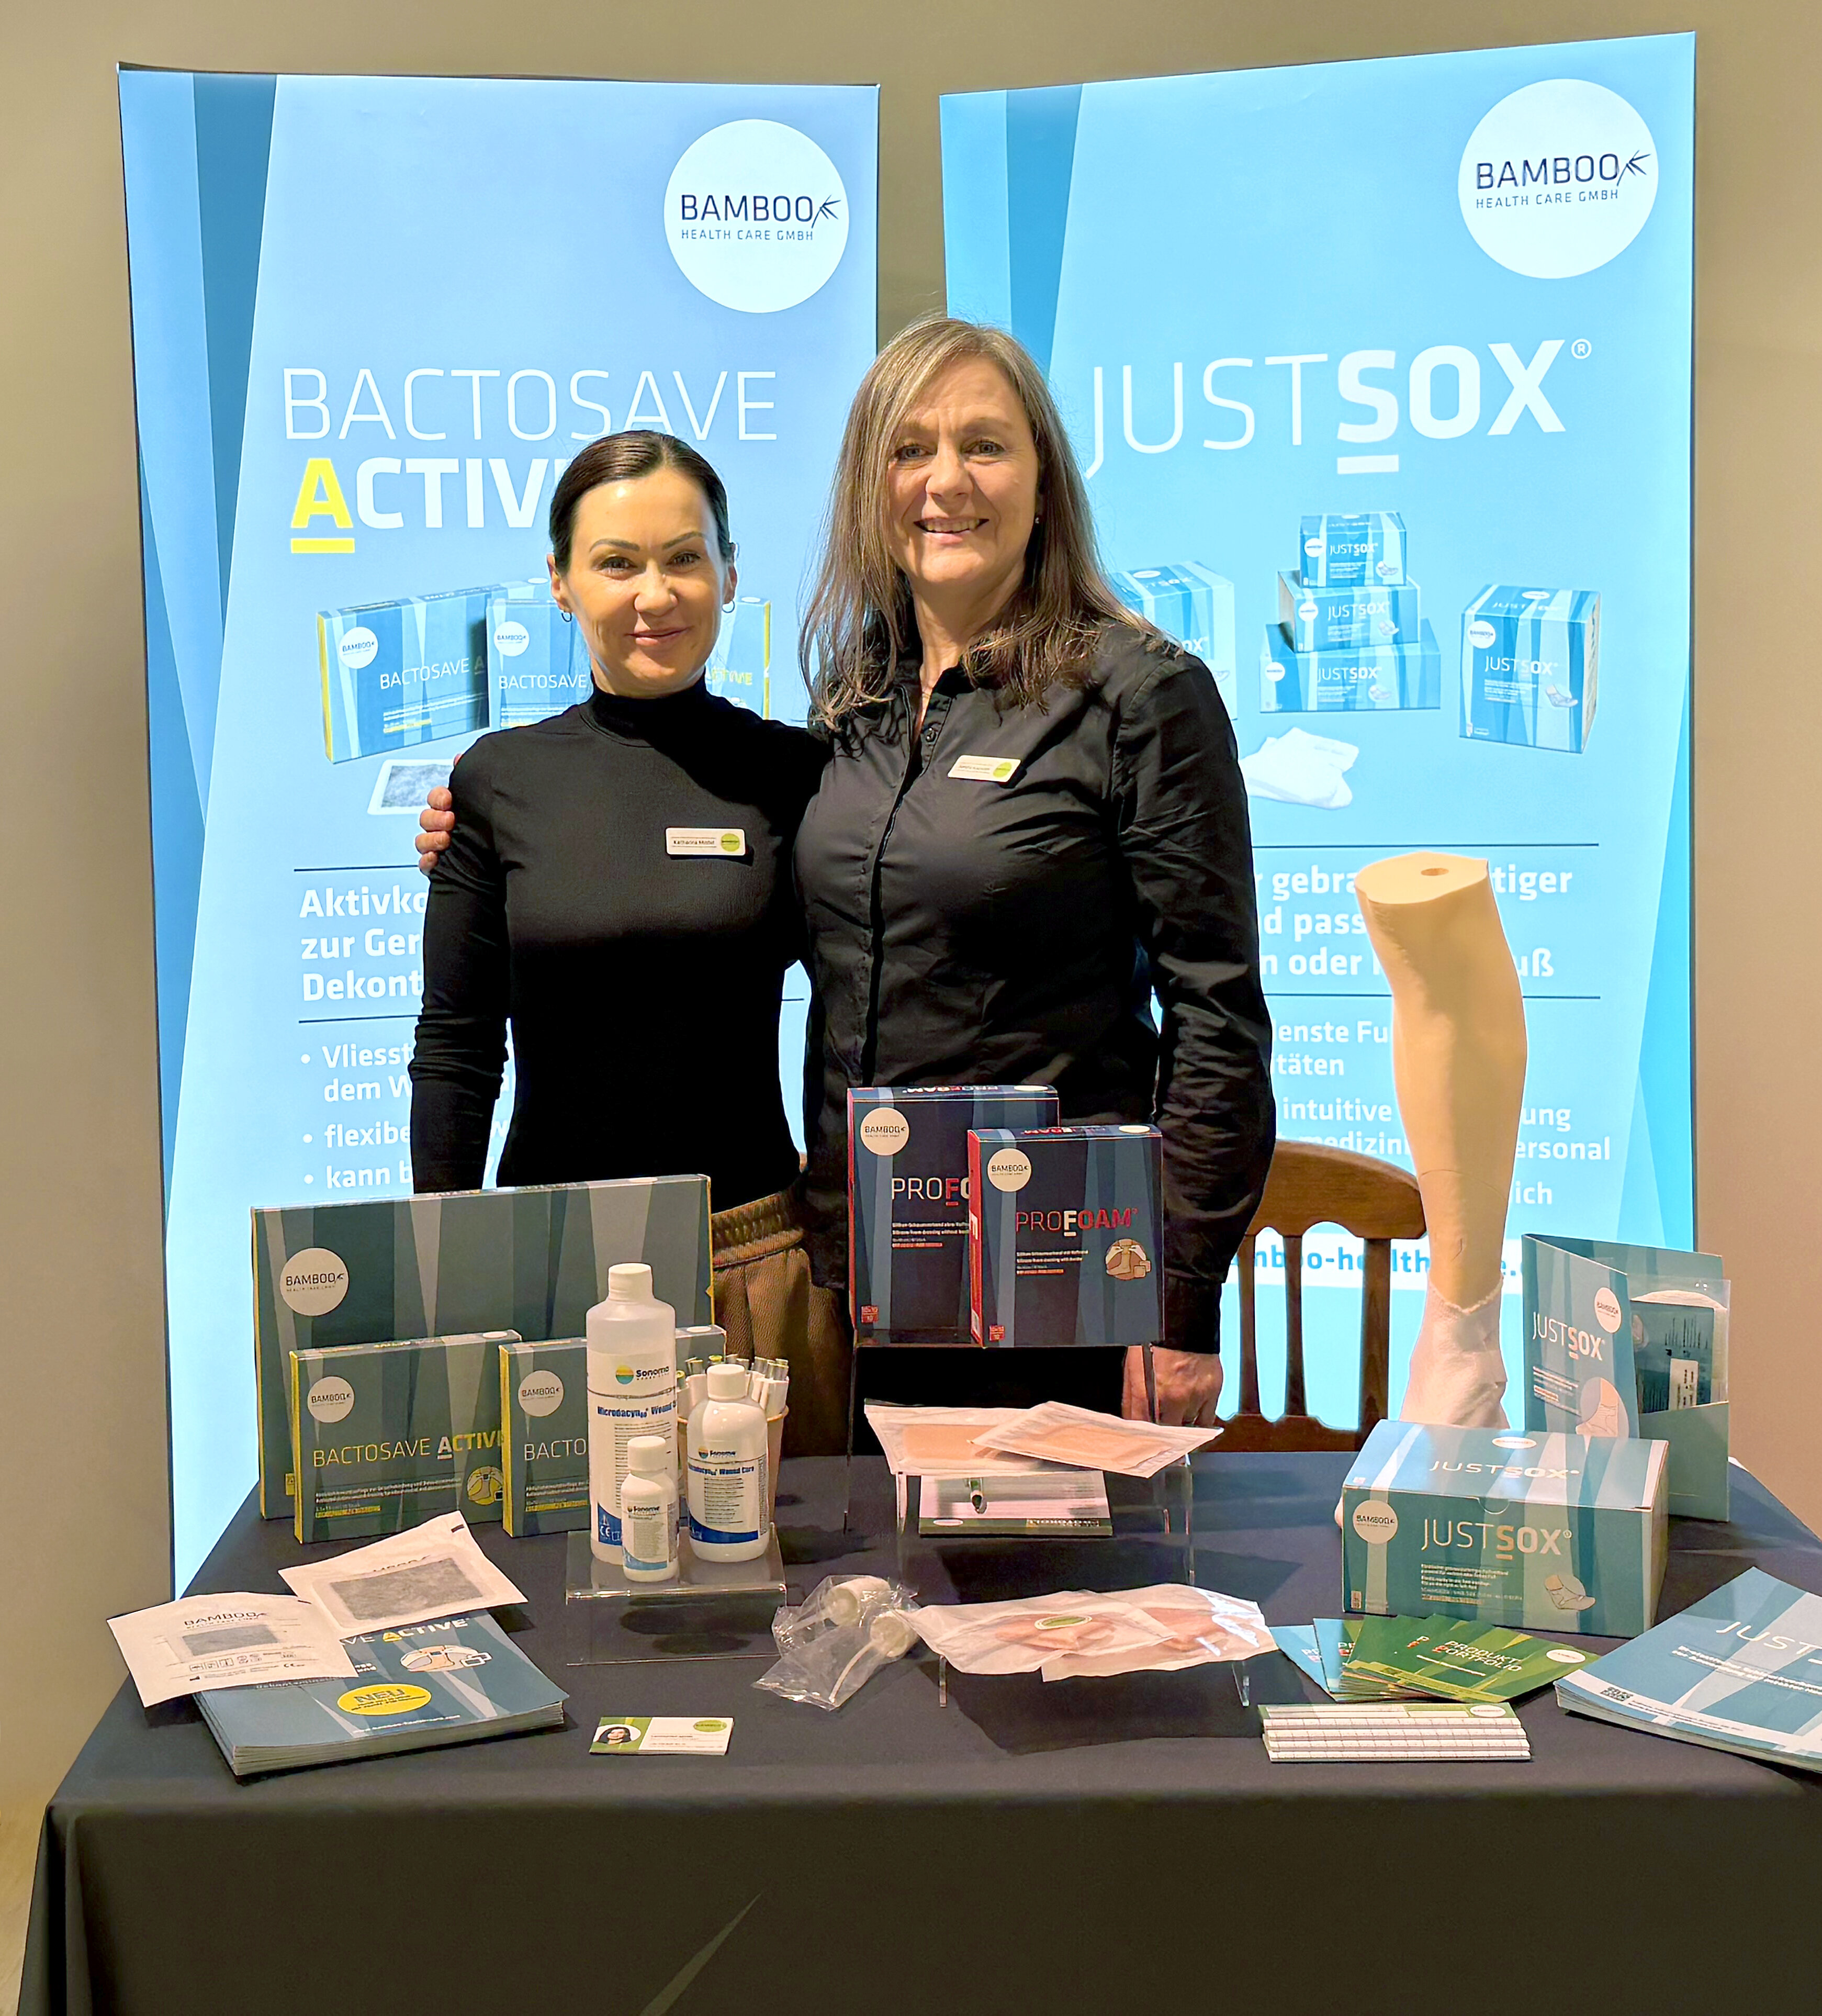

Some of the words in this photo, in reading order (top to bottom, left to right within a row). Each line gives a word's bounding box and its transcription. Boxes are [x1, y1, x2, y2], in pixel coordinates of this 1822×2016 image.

[1477, 153, 1619, 189] BAMBOO
[681, 194, 813, 222] BAMBOO
[1476, 193, 1529, 209] HEALTH
[1535, 192, 1572, 205] CARE
[1578, 189, 1619, 203] GMBH
[681, 229, 732, 240] HEALTH
[737, 230, 771, 240] CARE
[777, 230, 814, 241] GMBH
[283, 367, 778, 441] BACTOSAVE
[380, 658, 469, 689] BACTOSAVE
[499, 674, 587, 689] BACTOSAVE
[301, 936, 355, 960] zur
[1289, 946, 1362, 975] oder
[324, 1078, 380, 1103] dem
[1284, 1097, 1392, 1122] intuitive
[326, 1166, 390, 1189] kann
[286, 1273, 335, 1286] BAMBOO
[636, 1366, 669, 1377] Sonoma
[314, 1438, 430, 1468] BACTOSAVE
[184, 1612, 256, 1626] BAMBOO
[354, 1689, 405, 1703] NEU
